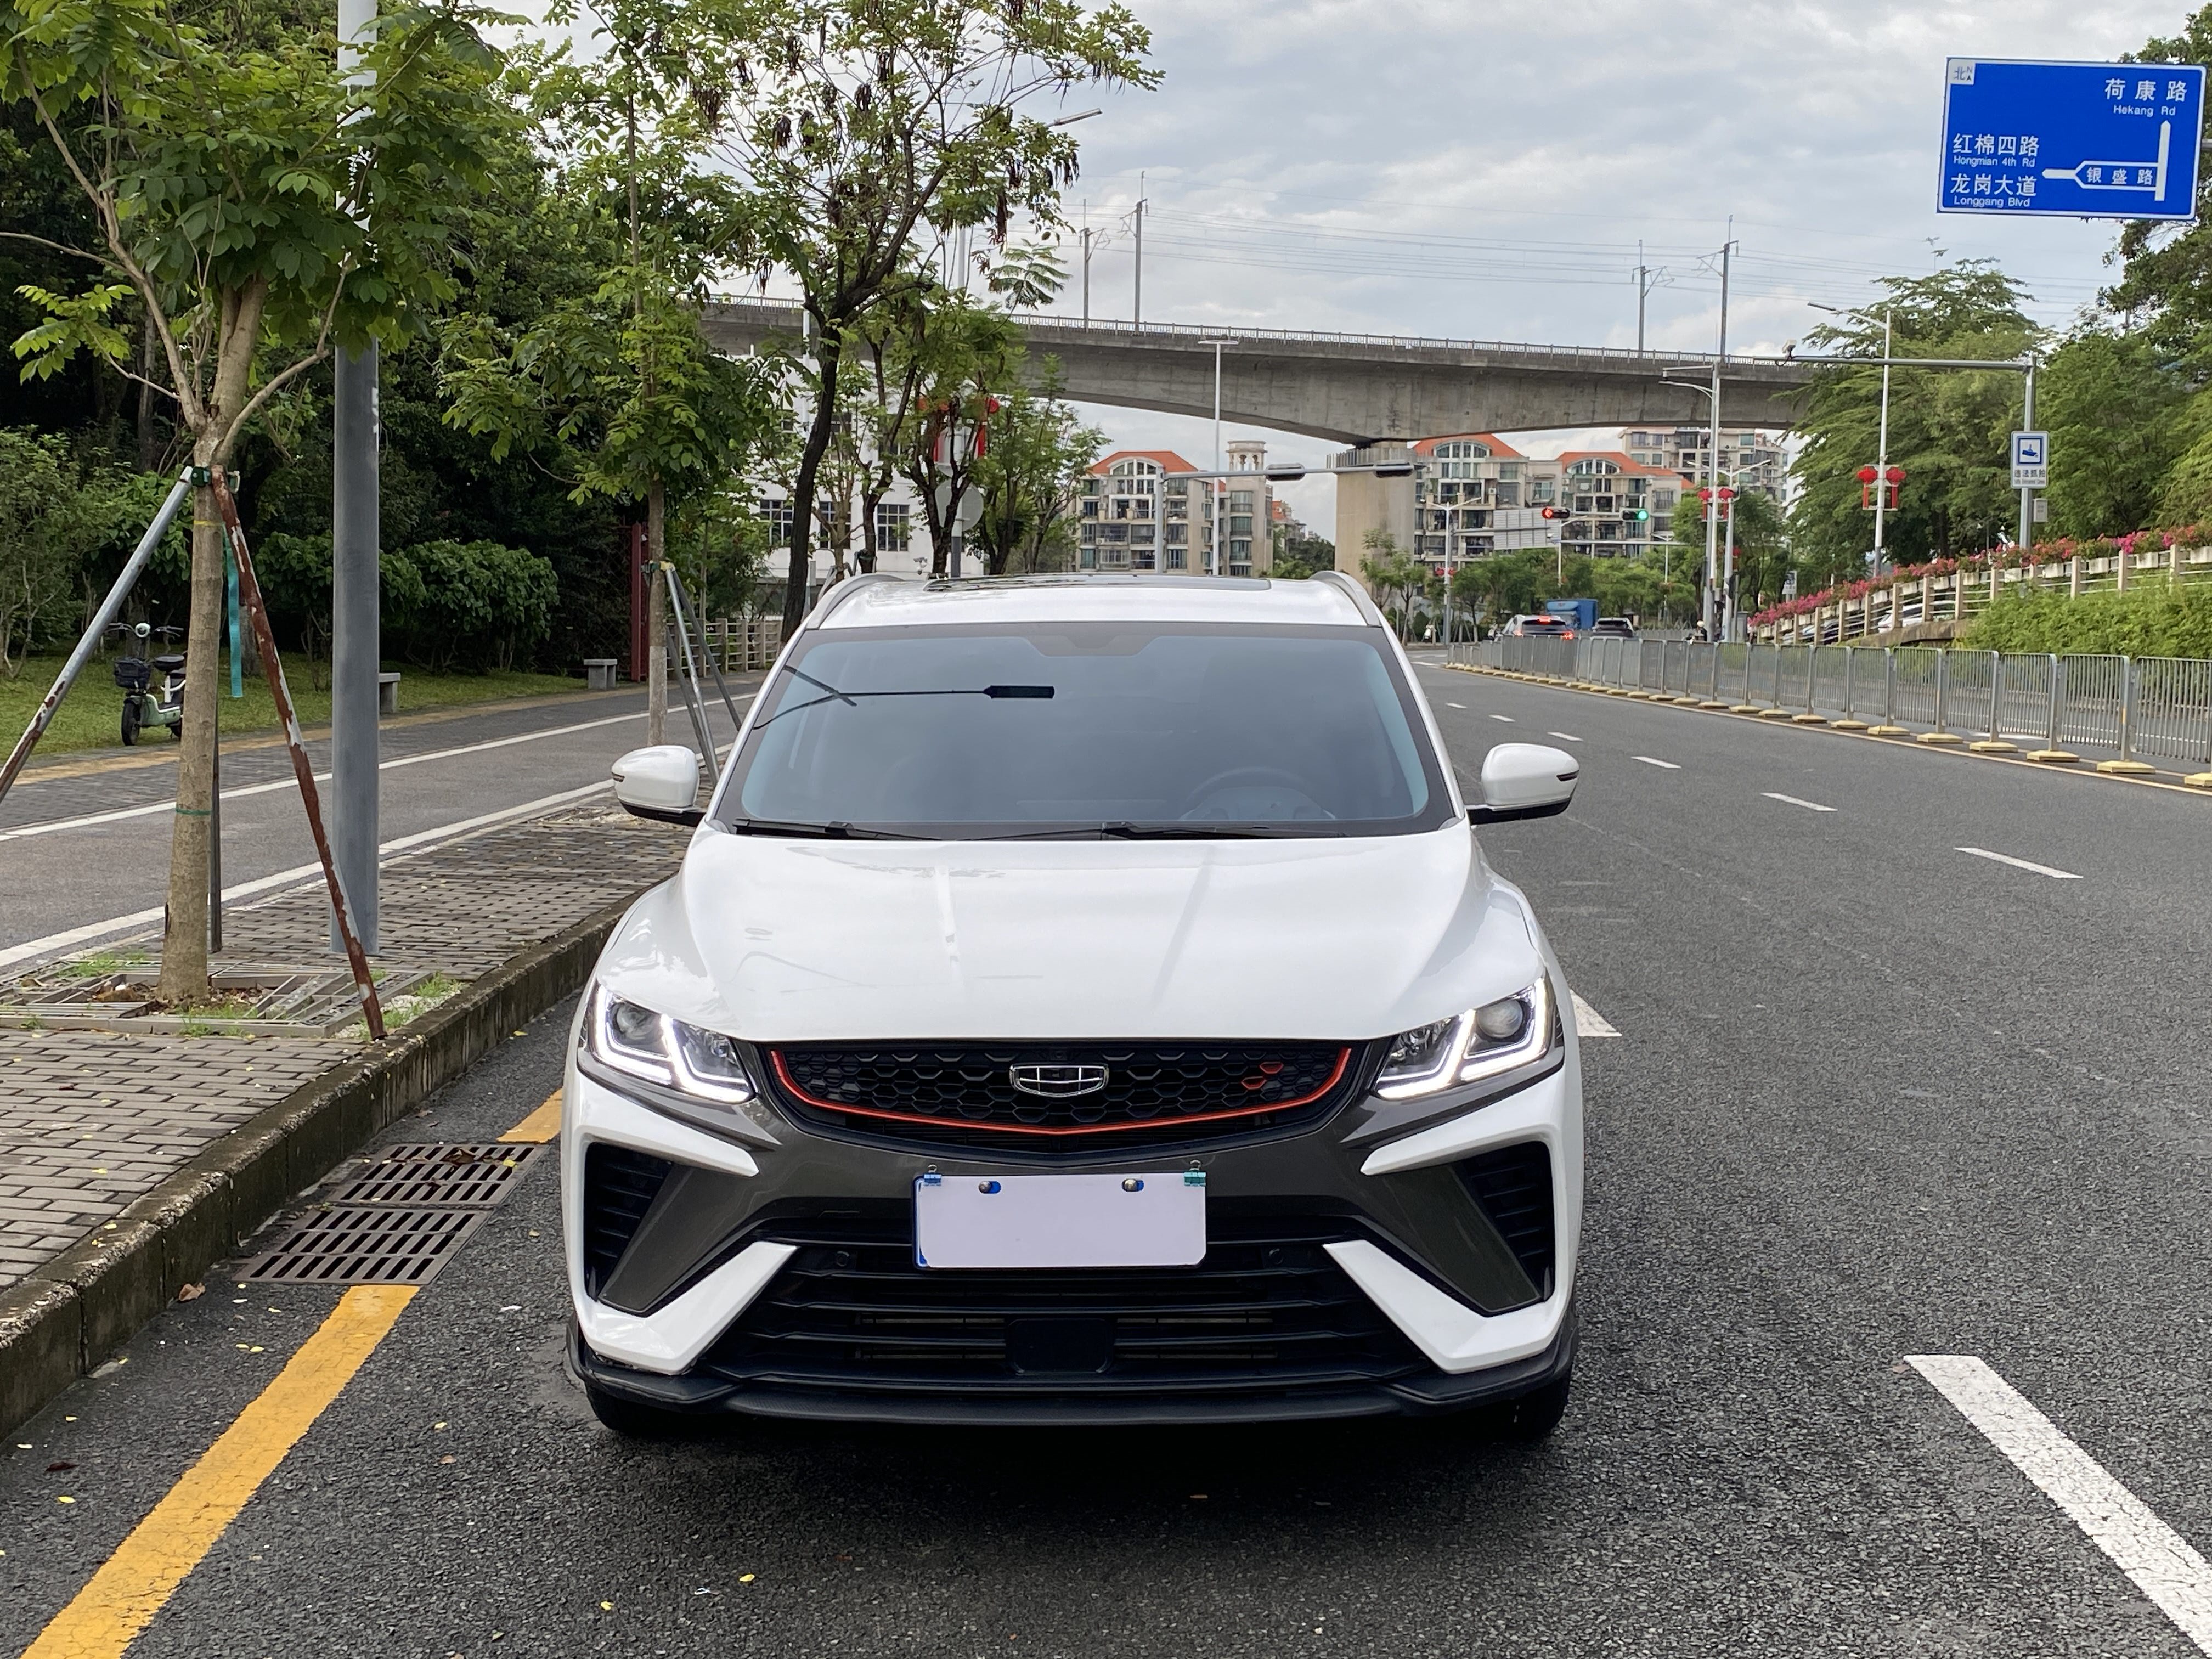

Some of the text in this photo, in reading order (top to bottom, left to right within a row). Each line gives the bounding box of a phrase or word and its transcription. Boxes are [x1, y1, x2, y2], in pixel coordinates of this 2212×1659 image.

[1953, 66, 1966, 81] 北
[2104, 78, 2187, 103] 荷康路
[2113, 104, 2176, 117] Hekang Rd
[1953, 133, 2040, 157] 红棉四路
[1953, 155, 2035, 167] Hongmian 4th Rd
[2086, 167, 2153, 185] 银盛路
[1950, 173, 2038, 197] 龙岗大道
[1954, 195, 2030, 208] Longgang Blvd
